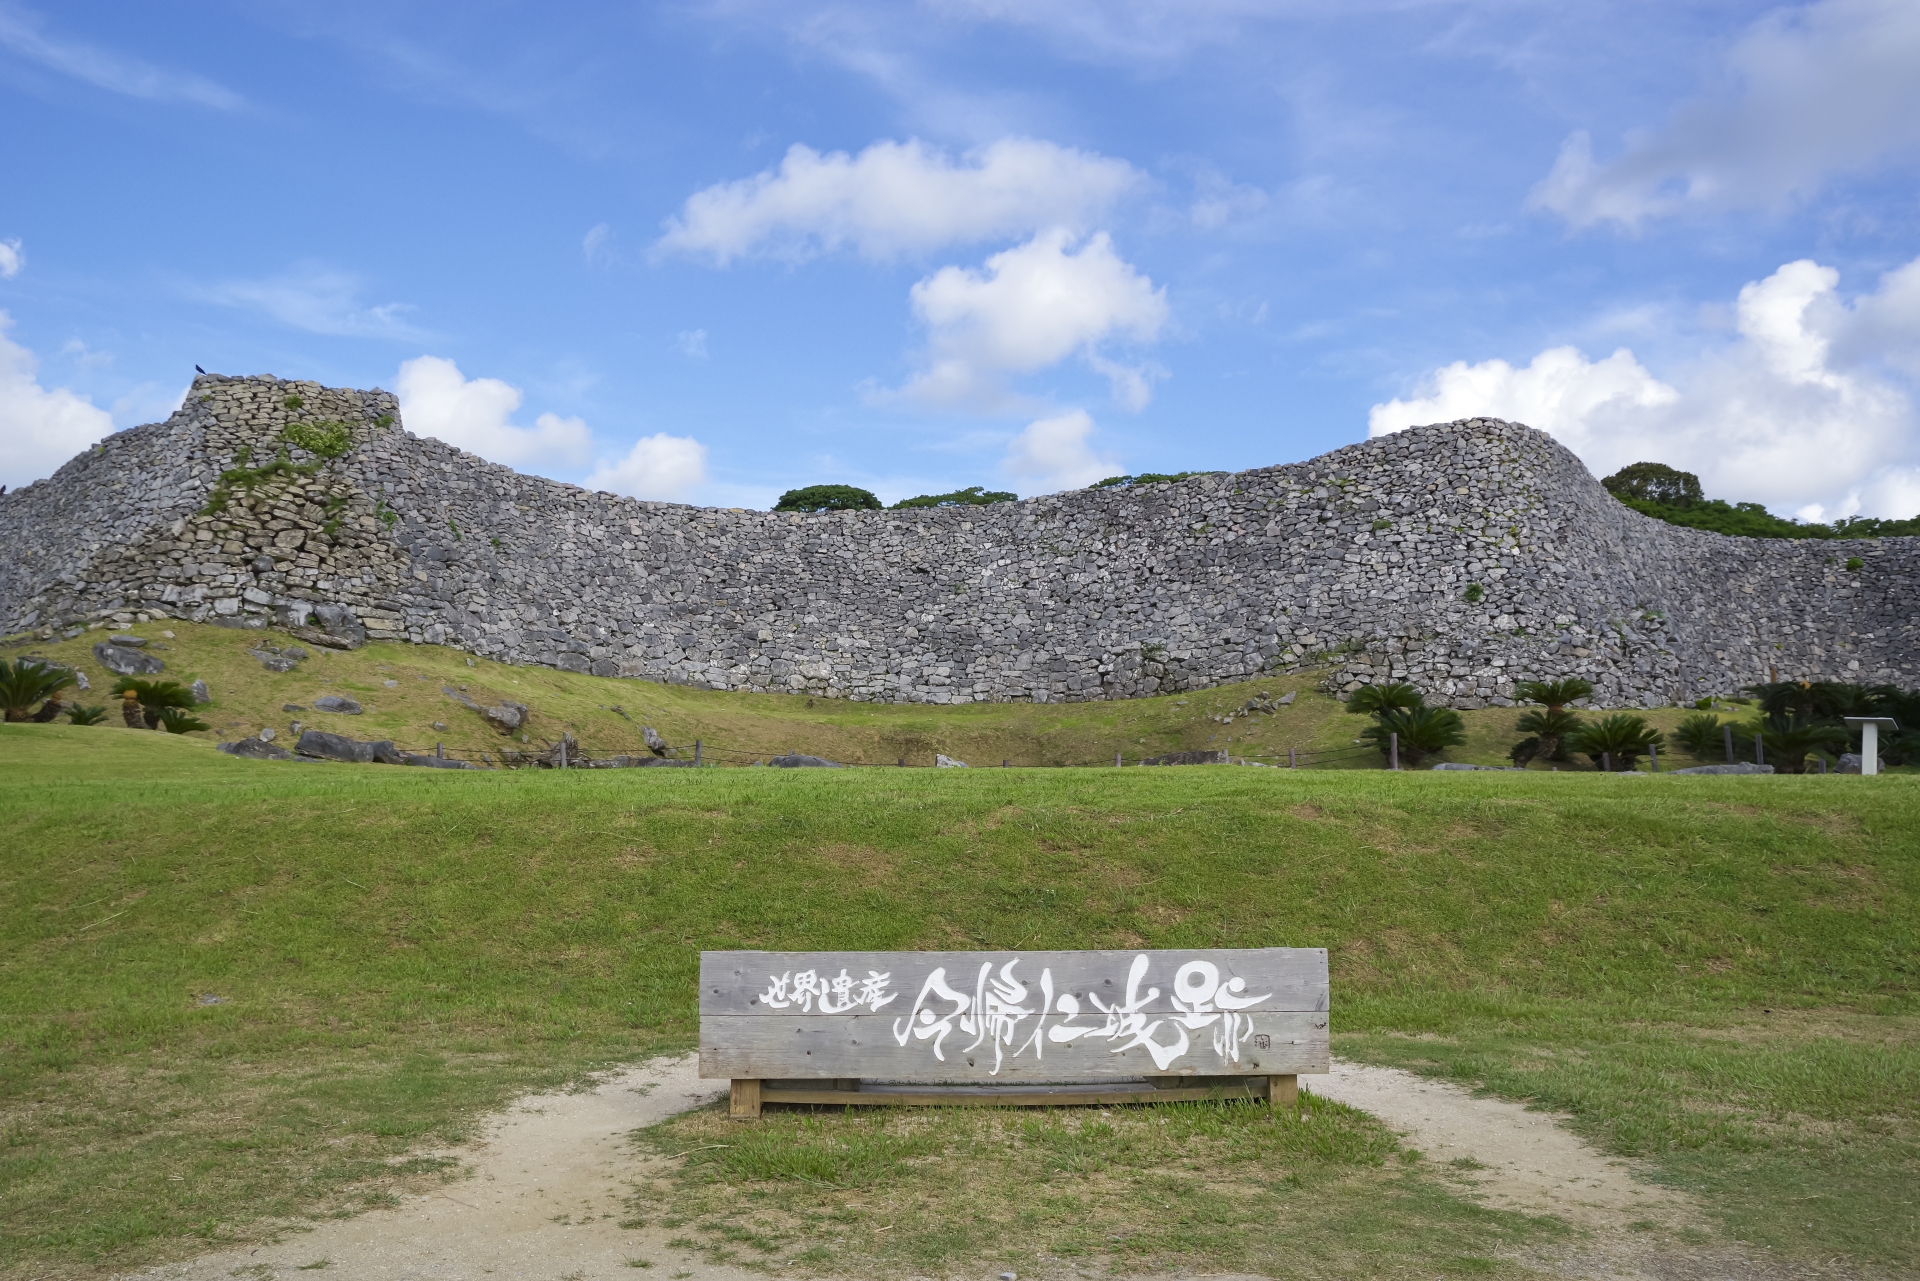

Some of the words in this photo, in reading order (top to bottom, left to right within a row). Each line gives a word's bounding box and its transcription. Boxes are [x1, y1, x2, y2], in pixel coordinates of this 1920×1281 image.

[759, 969, 899, 1013] 世界遺産
[893, 953, 1272, 1076] 今帰仁城跡
